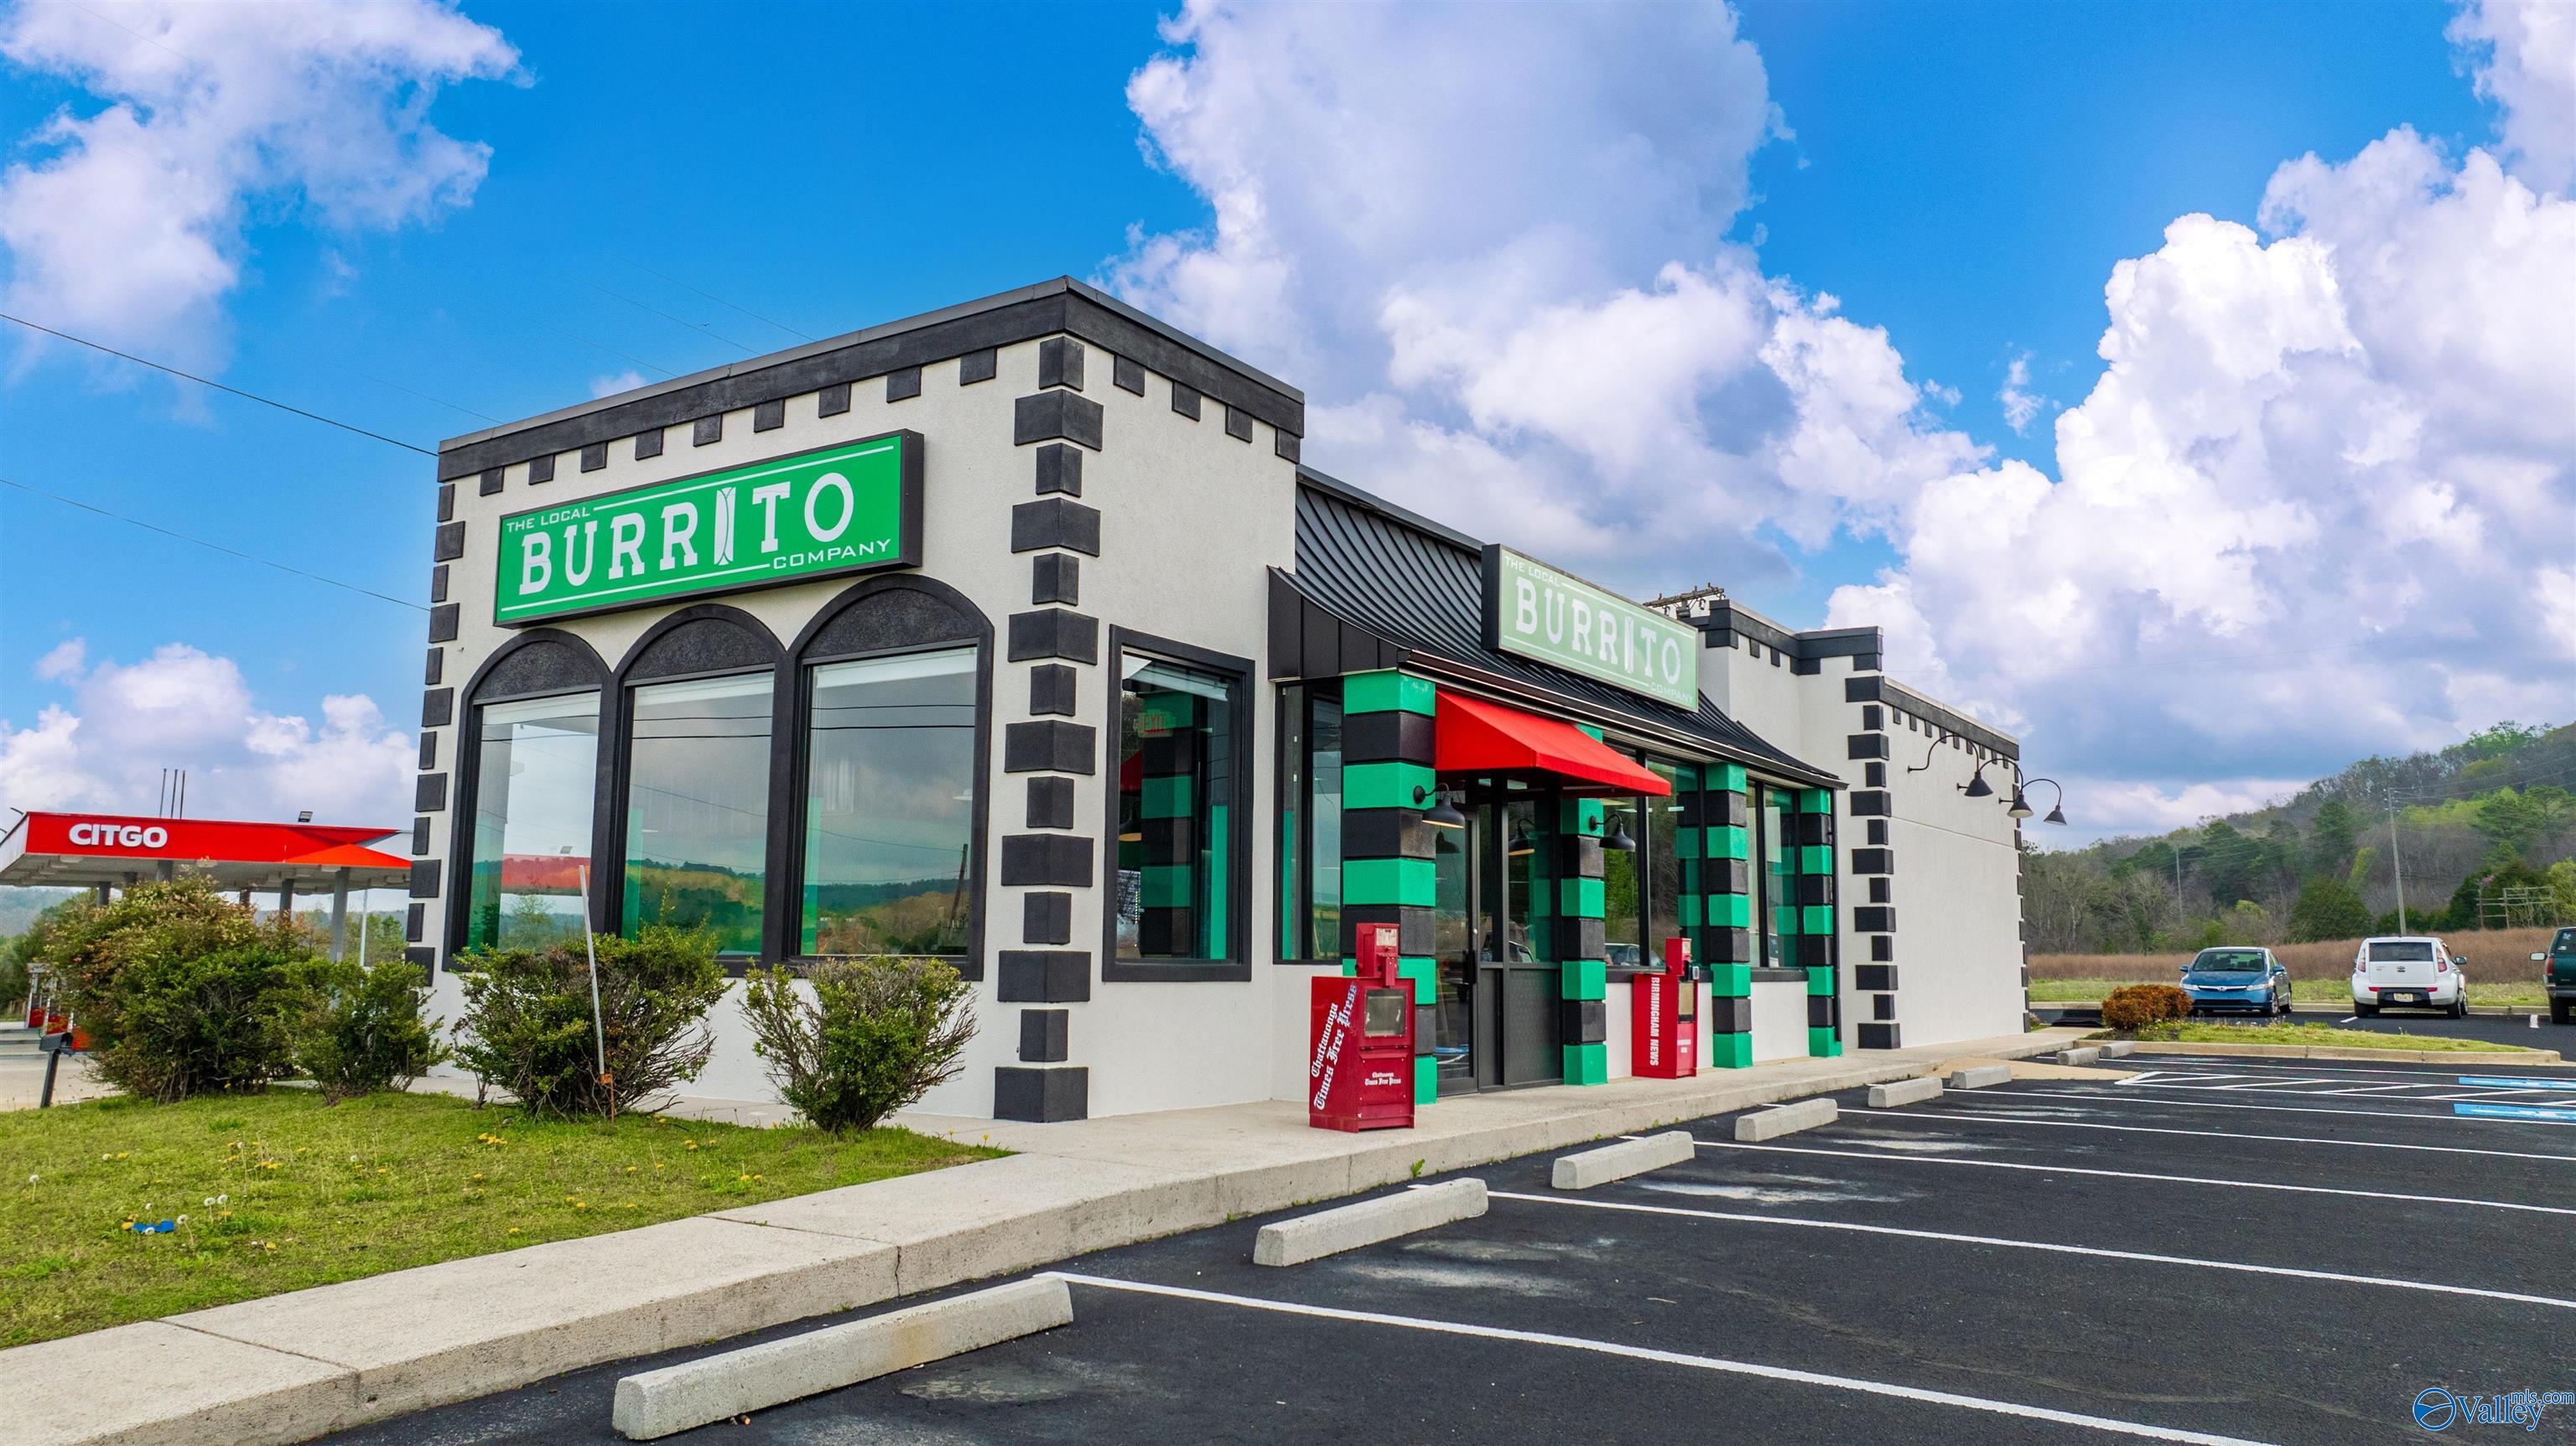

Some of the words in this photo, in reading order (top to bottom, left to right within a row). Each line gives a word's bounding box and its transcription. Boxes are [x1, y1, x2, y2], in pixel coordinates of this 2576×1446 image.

[506, 517, 535, 532] THE
[541, 507, 590, 526] LOCAL
[519, 472, 854, 596] BURRITO
[773, 538, 891, 570] COMPANY
[1504, 556, 1524, 573] THE
[1529, 567, 1561, 588] LOCAL
[1515, 576, 1681, 685] BURRITO
[1649, 682, 1694, 703] COMPANY
[69, 822, 168, 848] CITGO
[1650, 977, 1660, 1037] BIRMINGHAM
[1311, 1003, 1338, 1078] Chattanooga
[1313, 1065, 1334, 1111] Times
[1327, 1029, 1345, 1065] Free
[1337, 983, 1358, 1028] Press
[1649, 1039, 1659, 1066] NEWS
